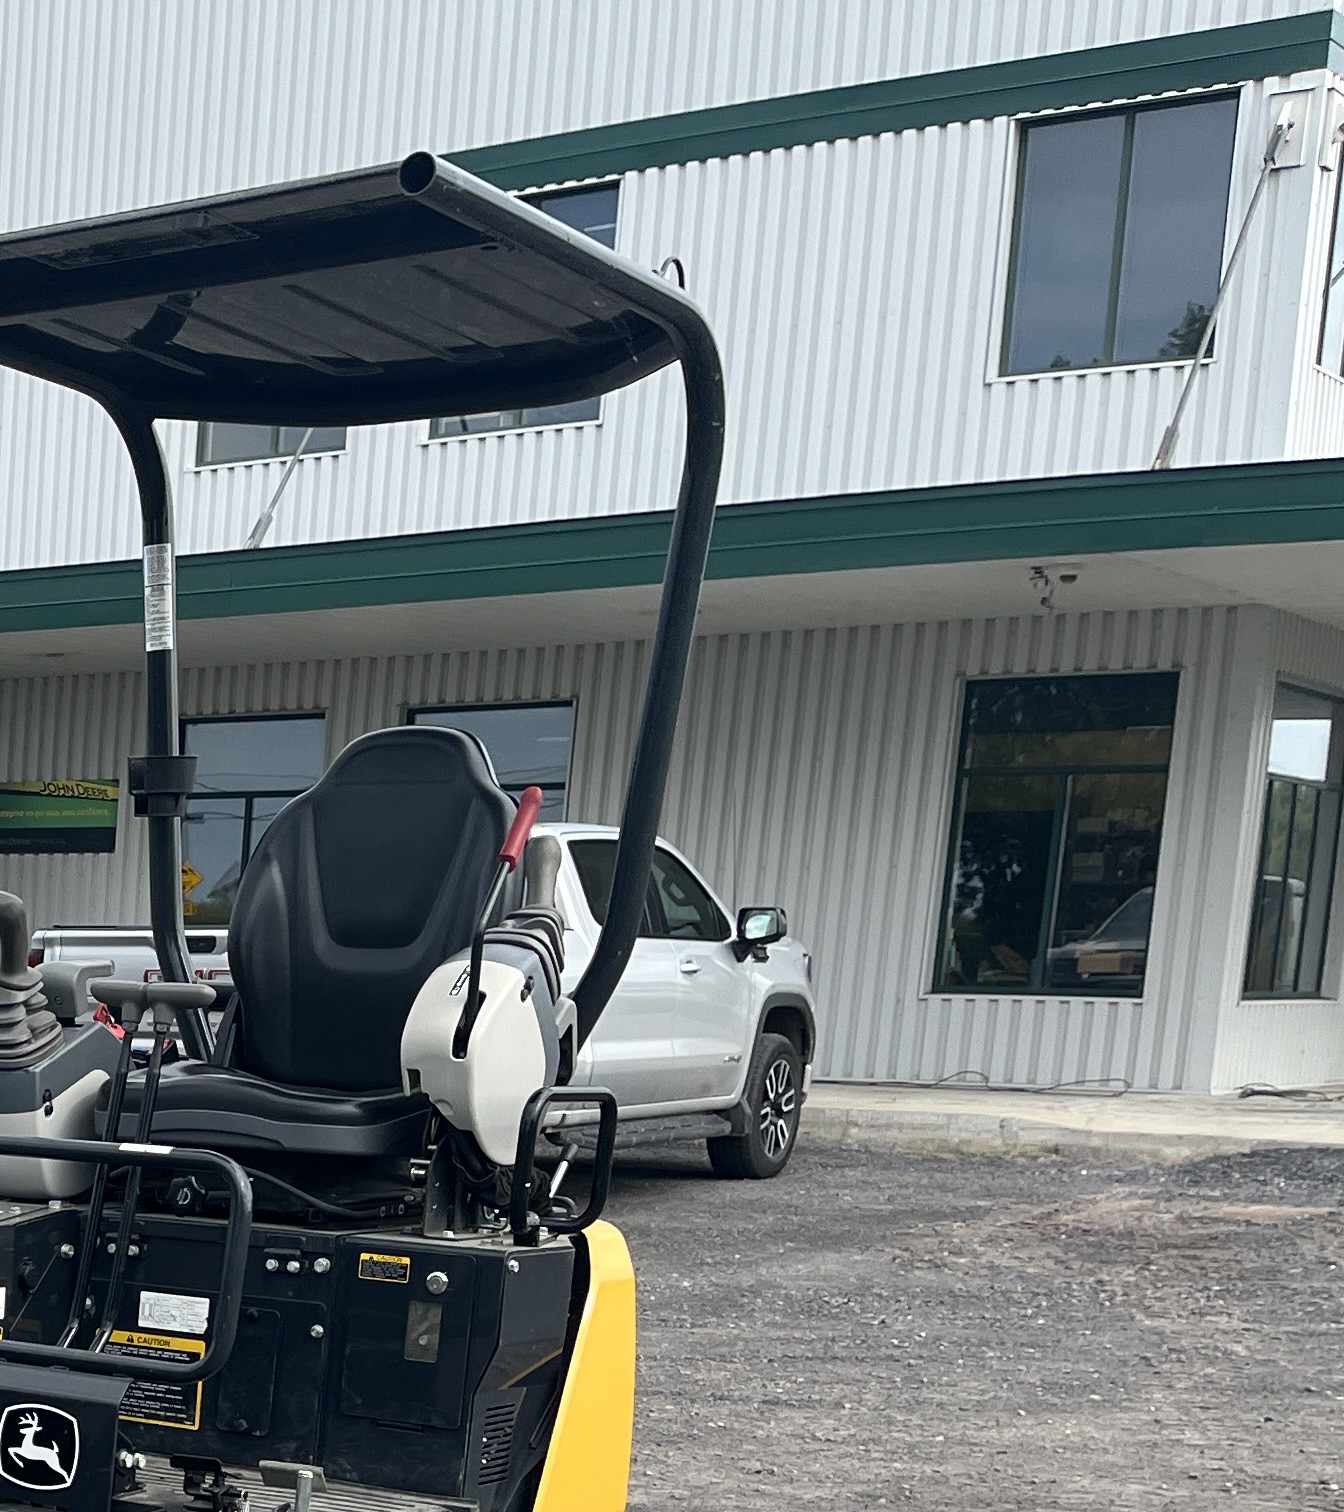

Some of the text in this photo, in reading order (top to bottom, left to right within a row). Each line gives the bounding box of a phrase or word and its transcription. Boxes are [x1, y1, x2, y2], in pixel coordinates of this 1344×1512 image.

[39, 781, 111, 798] JOHN DEERE
[137, 1335, 171, 1348] CAUTION
